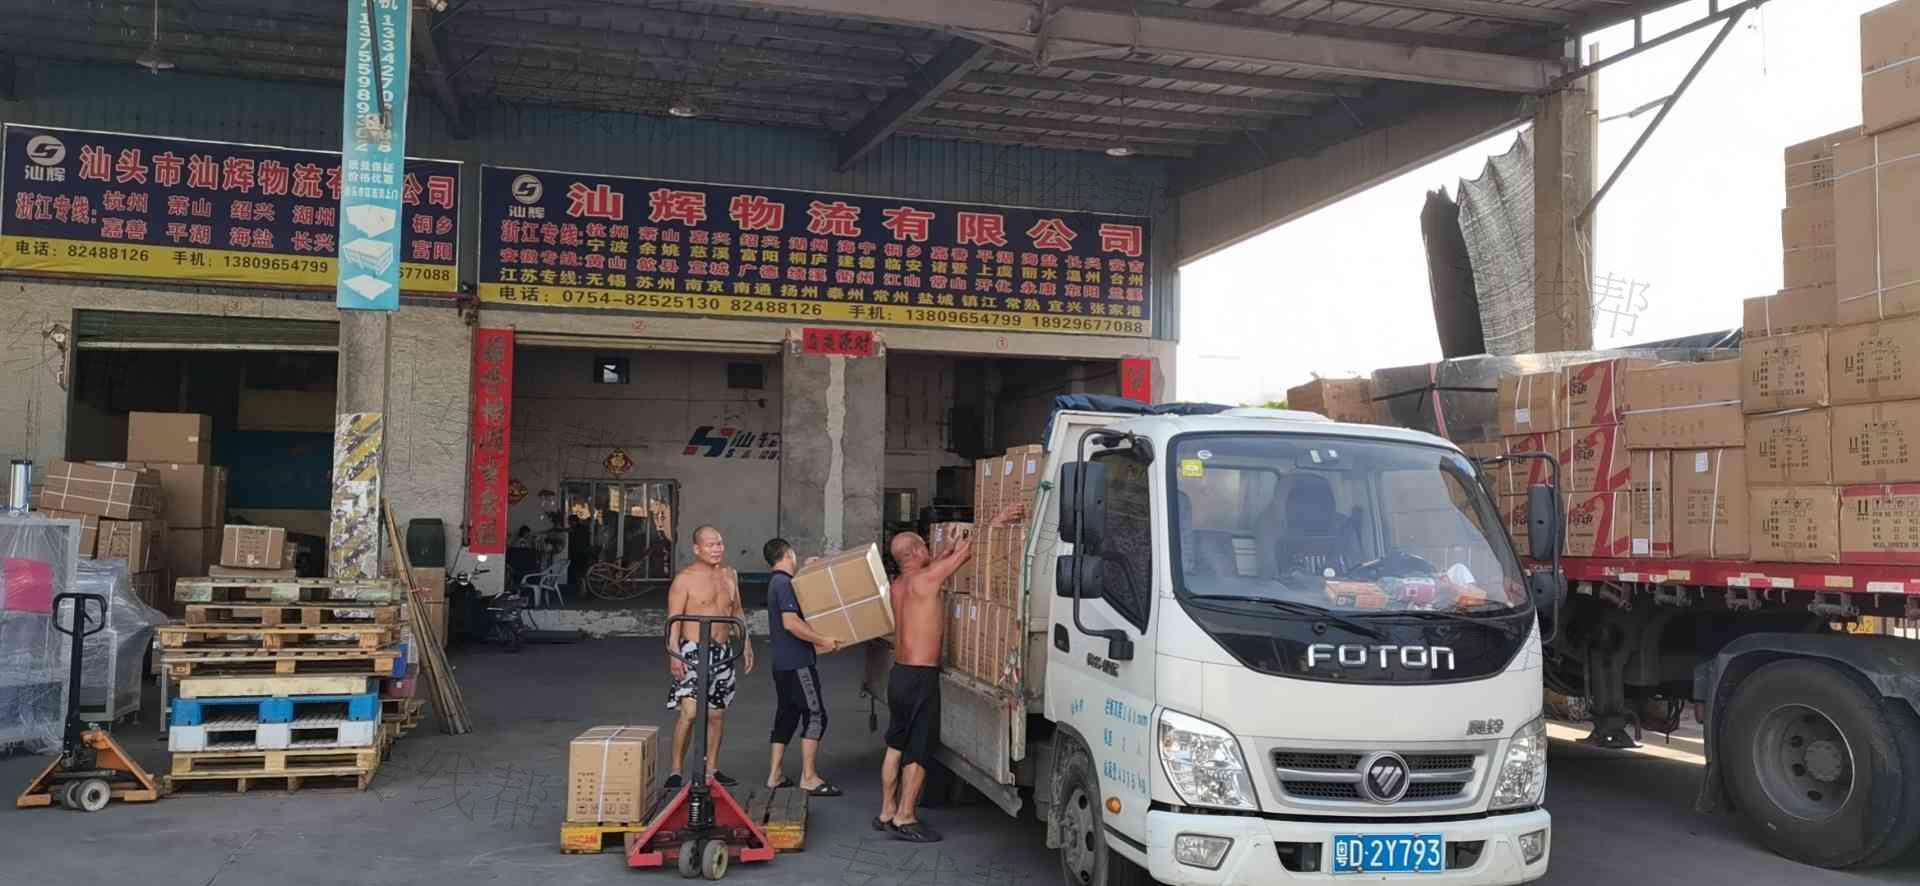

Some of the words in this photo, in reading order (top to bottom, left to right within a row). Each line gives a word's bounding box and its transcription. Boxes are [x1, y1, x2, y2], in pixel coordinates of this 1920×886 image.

[24, 164, 64, 183] 汕辉
[78, 144, 455, 208] 汕头市汕辉物流公司
[103, 190, 148, 213] 杭州
[168, 194, 211, 217] 萧山
[230, 199, 275, 222] 绍兴
[291, 203, 335, 226] 湖州
[412, 212, 453, 234] 桐乡
[508, 205, 544, 219] 汕辉
[566, 180, 1141, 256] 汕辉物流有限公司
[101, 217, 147, 240] 嘉善
[165, 222, 211, 244] 平湖
[229, 226, 273, 248] 海盐
[291, 230, 335, 252] 长兴
[412, 238, 452, 259] 富阳
[587, 238, 627, 253] 宁波
[67, 243, 149, 262] 82488126
[223, 253, 328, 273] 13809654799
[636, 275, 674, 290] 苏州
[563, 289, 720, 311] 0754-82525130
[730, 299, 821, 316] 82488126
[906, 308, 1020, 326] 13809654799
[1032, 315, 1142, 333] 18929677088
[1307, 643, 1455, 670] FOTON
